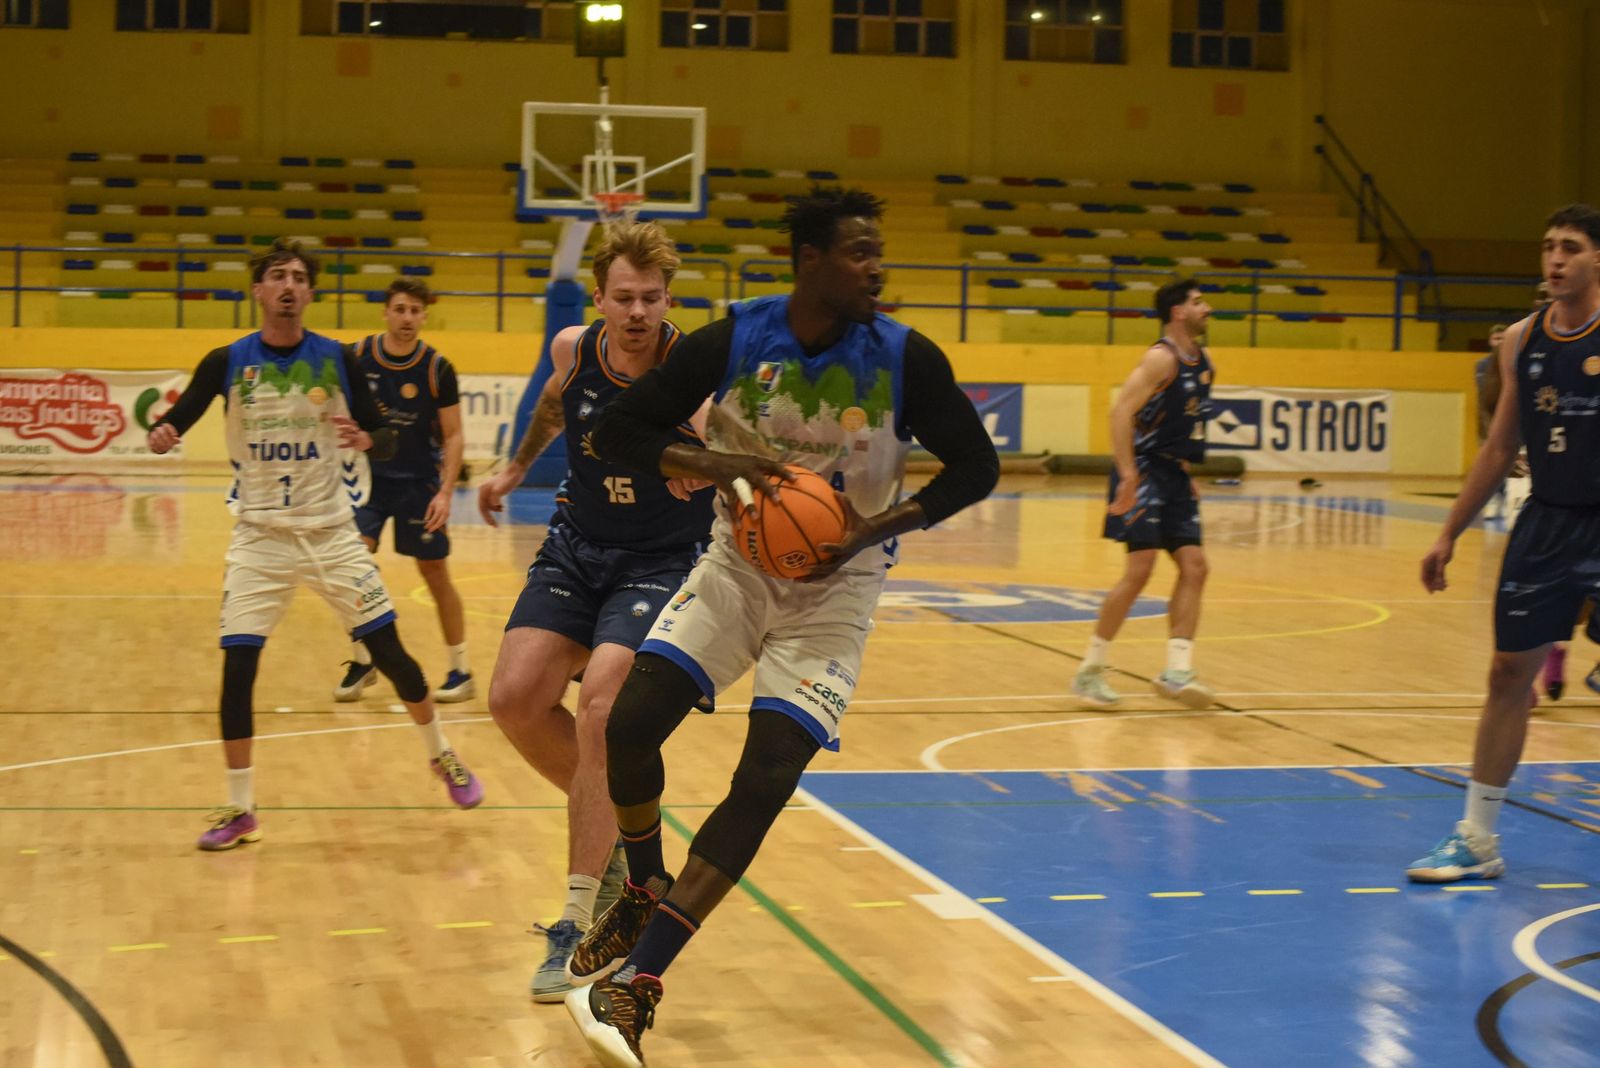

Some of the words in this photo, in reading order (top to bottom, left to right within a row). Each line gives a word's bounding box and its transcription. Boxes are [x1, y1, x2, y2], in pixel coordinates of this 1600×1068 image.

[1271, 400, 1387, 452] STROG
[1547, 426, 1567, 453] 5
[278, 474, 291, 506] 1
[603, 476, 636, 504] 15
[795, 687, 820, 705] Grupo
